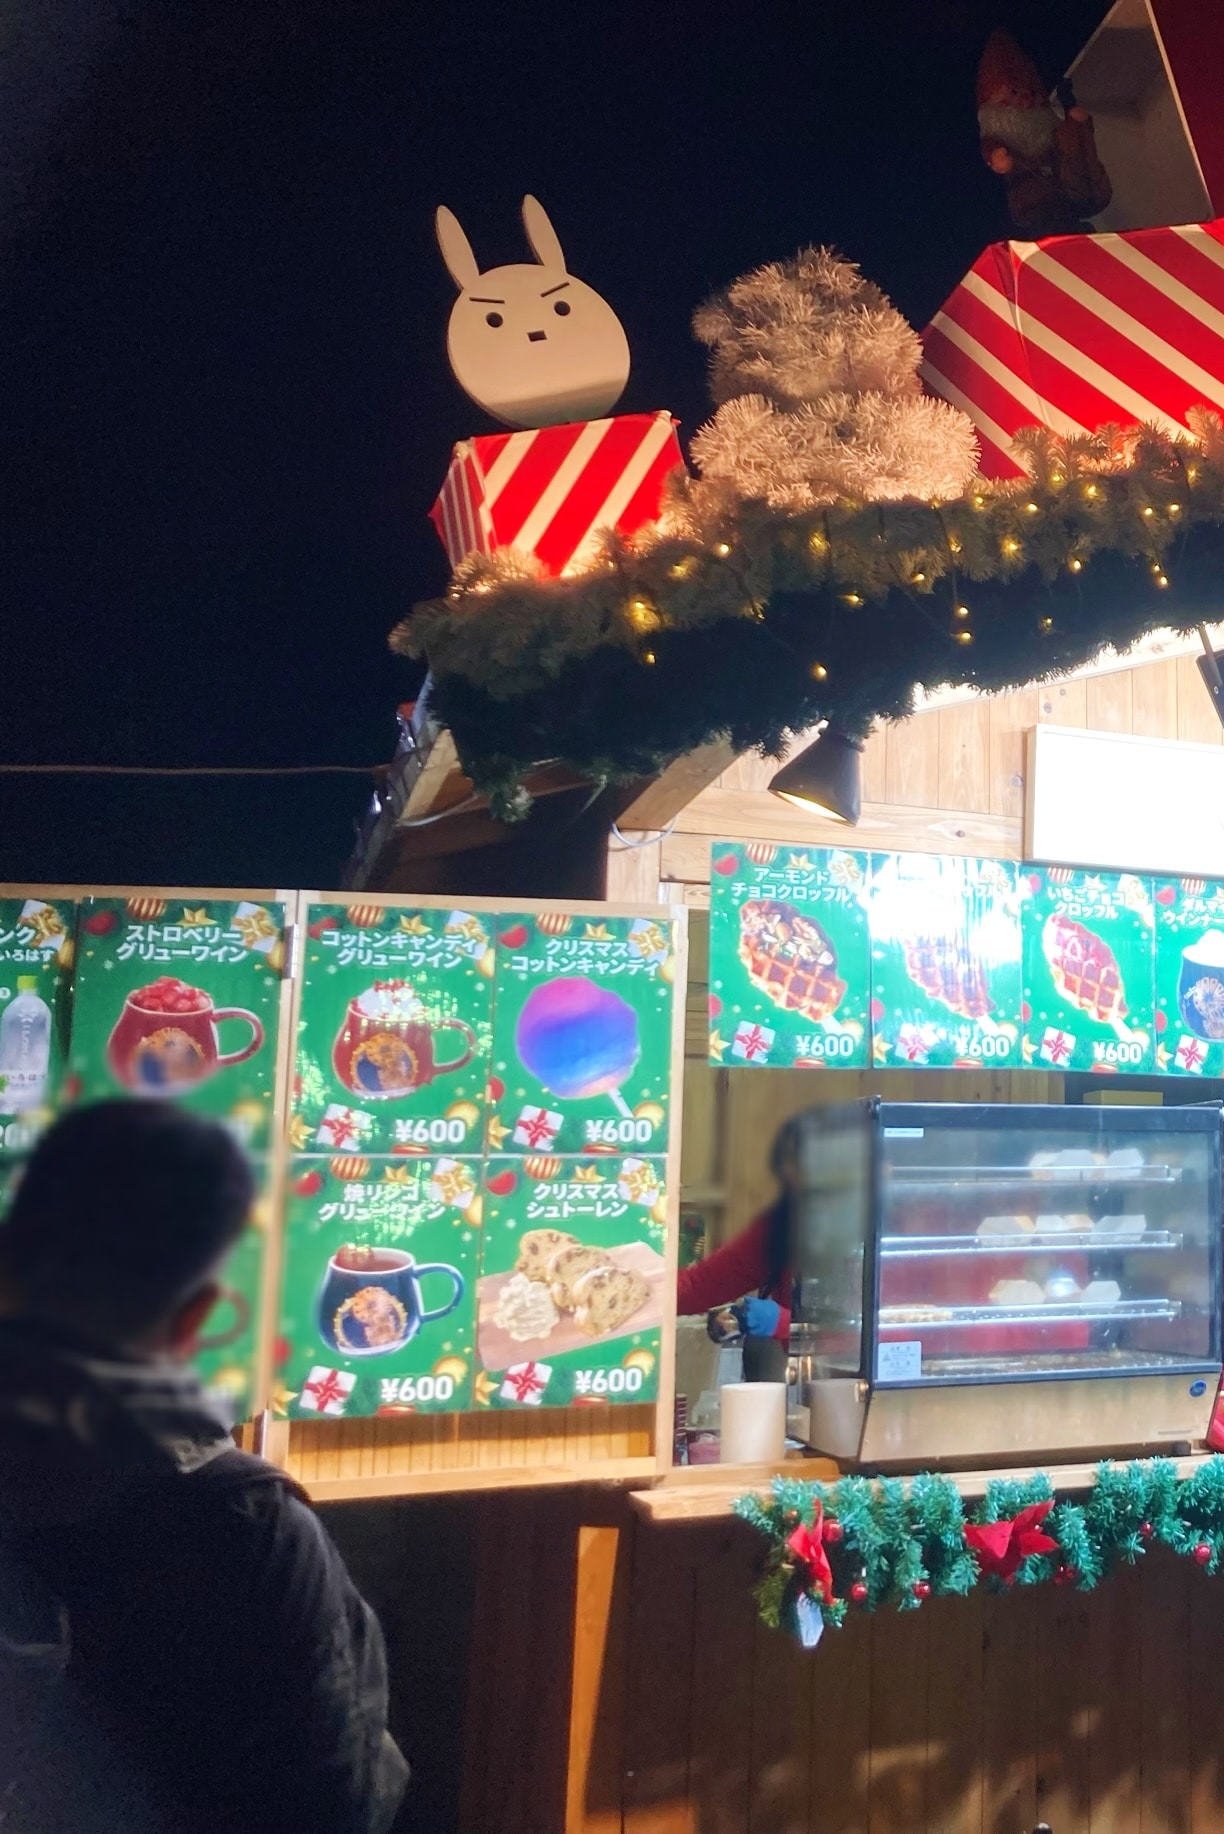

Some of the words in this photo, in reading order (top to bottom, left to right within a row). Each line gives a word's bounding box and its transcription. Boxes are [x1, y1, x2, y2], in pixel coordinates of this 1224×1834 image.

[753, 867, 830, 882] アーモンド
[731, 883, 850, 901] チョコクロッフル
[1047, 886, 1125, 905] いちごチョコ
[1055, 901, 1118, 919] クロッフル
[125, 924, 242, 942] ストロベリー
[321, 929, 478, 953] コットンキャンディ
[116, 942, 248, 962] グリューワイン
[545, 938, 630, 957] クリスマス
[337, 950, 462, 968] グリューワイン
[511, 955, 661, 976] コットンキャンディ
[796, 1034, 854, 1056] ¥600
[954, 1034, 1010, 1056] ¥600
[1093, 1041, 1142, 1062] ¥600
[395, 1118, 466, 1143] ¥600
[586, 1118, 652, 1142] ¥600
[534, 1183, 620, 1201] クリスマス
[526, 1200, 629, 1218] シュトーレン
[381, 1375, 454, 1401] ¥600
[575, 1368, 643, 1393] ¥600
